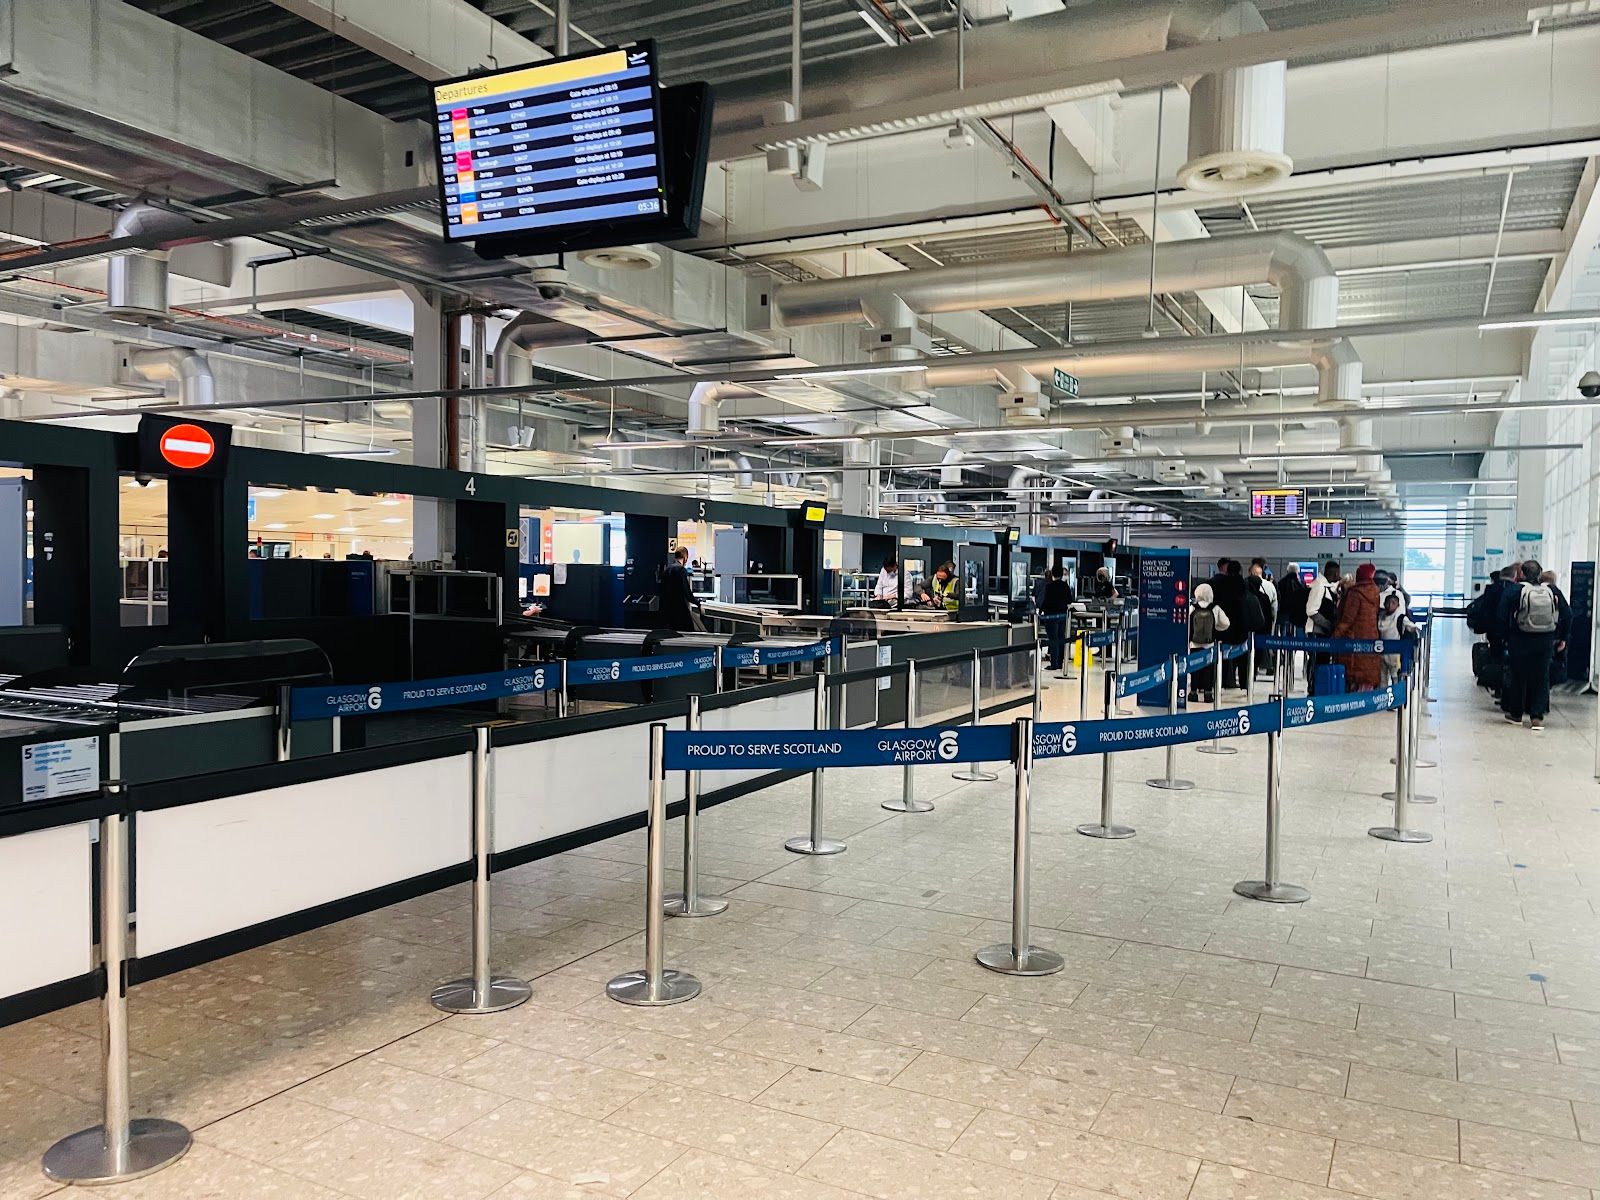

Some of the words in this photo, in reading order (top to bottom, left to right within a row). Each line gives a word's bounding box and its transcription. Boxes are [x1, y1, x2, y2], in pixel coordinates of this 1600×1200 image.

[436, 84, 488, 102] Departures
[638, 201, 659, 211] 05:36
[465, 476, 476, 496] 4
[699, 502, 706, 517] 5
[883, 521, 888, 533] 6
[504, 675, 533, 687] GLASGOW
[512, 682, 533, 693] AIRPORT
[403, 690, 425, 700] PROUD
[426, 688, 436, 698] TO
[436, 686, 455, 696] SERVE
[455, 682, 487, 694] SCOTLAND
[326, 694, 367, 705] GLASGOW
[338, 702, 367, 712] AIRPORT
[1206, 717, 1239, 731] GLASGOW
[1100, 731, 1123, 742] PROUD
[1124, 730, 1135, 740] TO
[1135, 728, 1154, 739] SERVE
[1155, 725, 1189, 738] SCOTLAND
[1215, 727, 1239, 738] AIRPORT
[687, 744, 727, 756] PROUD
[729, 744, 745, 756] TO
[747, 743, 781, 755] SERVE
[783, 742, 842, 754] SCOTLAND
[877, 738, 938, 751] GLASGOW
[24, 748, 32, 760] 5
[894, 749, 937, 762] AIRPORT
